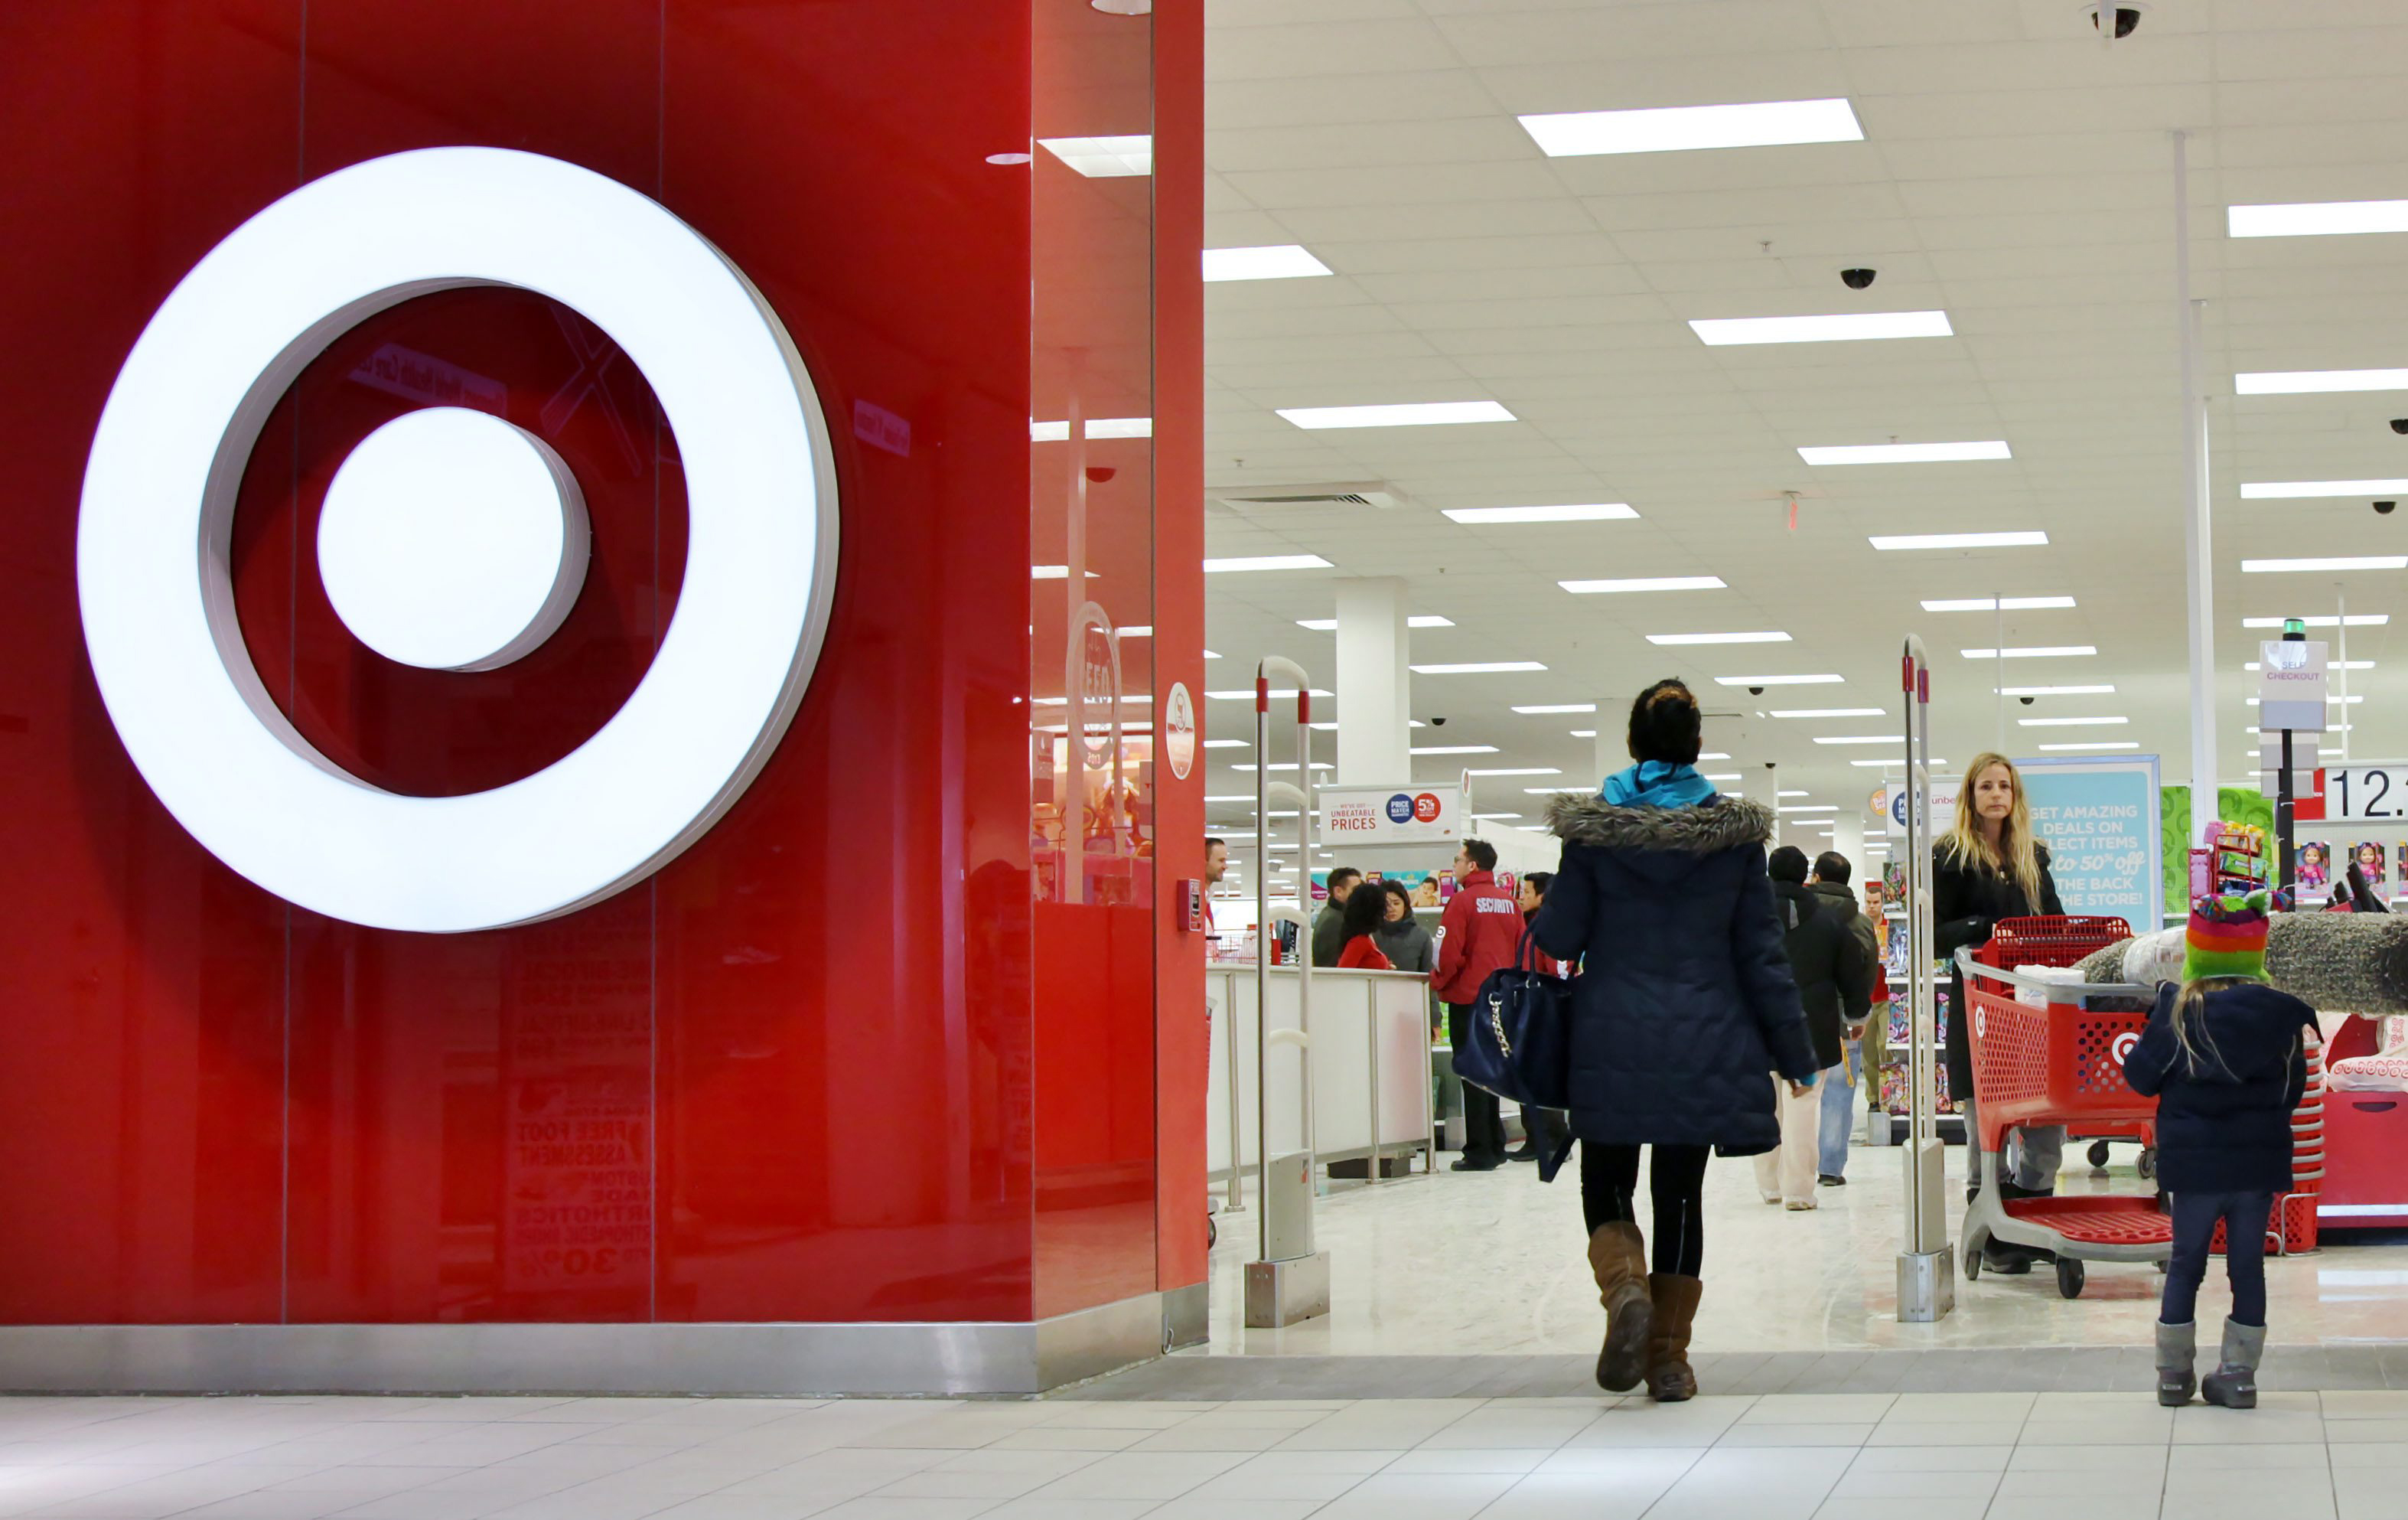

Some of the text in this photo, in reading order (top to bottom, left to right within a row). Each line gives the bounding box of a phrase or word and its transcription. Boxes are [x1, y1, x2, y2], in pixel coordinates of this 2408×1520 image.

[2282, 661, 2305, 670] SELF
[2332, 770, 2408, 817] 12.
[1419, 799, 1435, 811] 5%
[1331, 809, 1376, 817] UNBEATABLE
[2030, 806, 2137, 820] GET AMAZING
[1331, 817, 1376, 830] PRICES
[2043, 821, 2123, 835] DEALS ON
[2048, 837, 2138, 850] LECT ITEMS
[2055, 851, 2146, 875] to 50% off
[2055, 877, 2134, 890] THE BACK
[2087, 892, 2143, 906] STORE!
[1476, 898, 1514, 915] SECURITY
